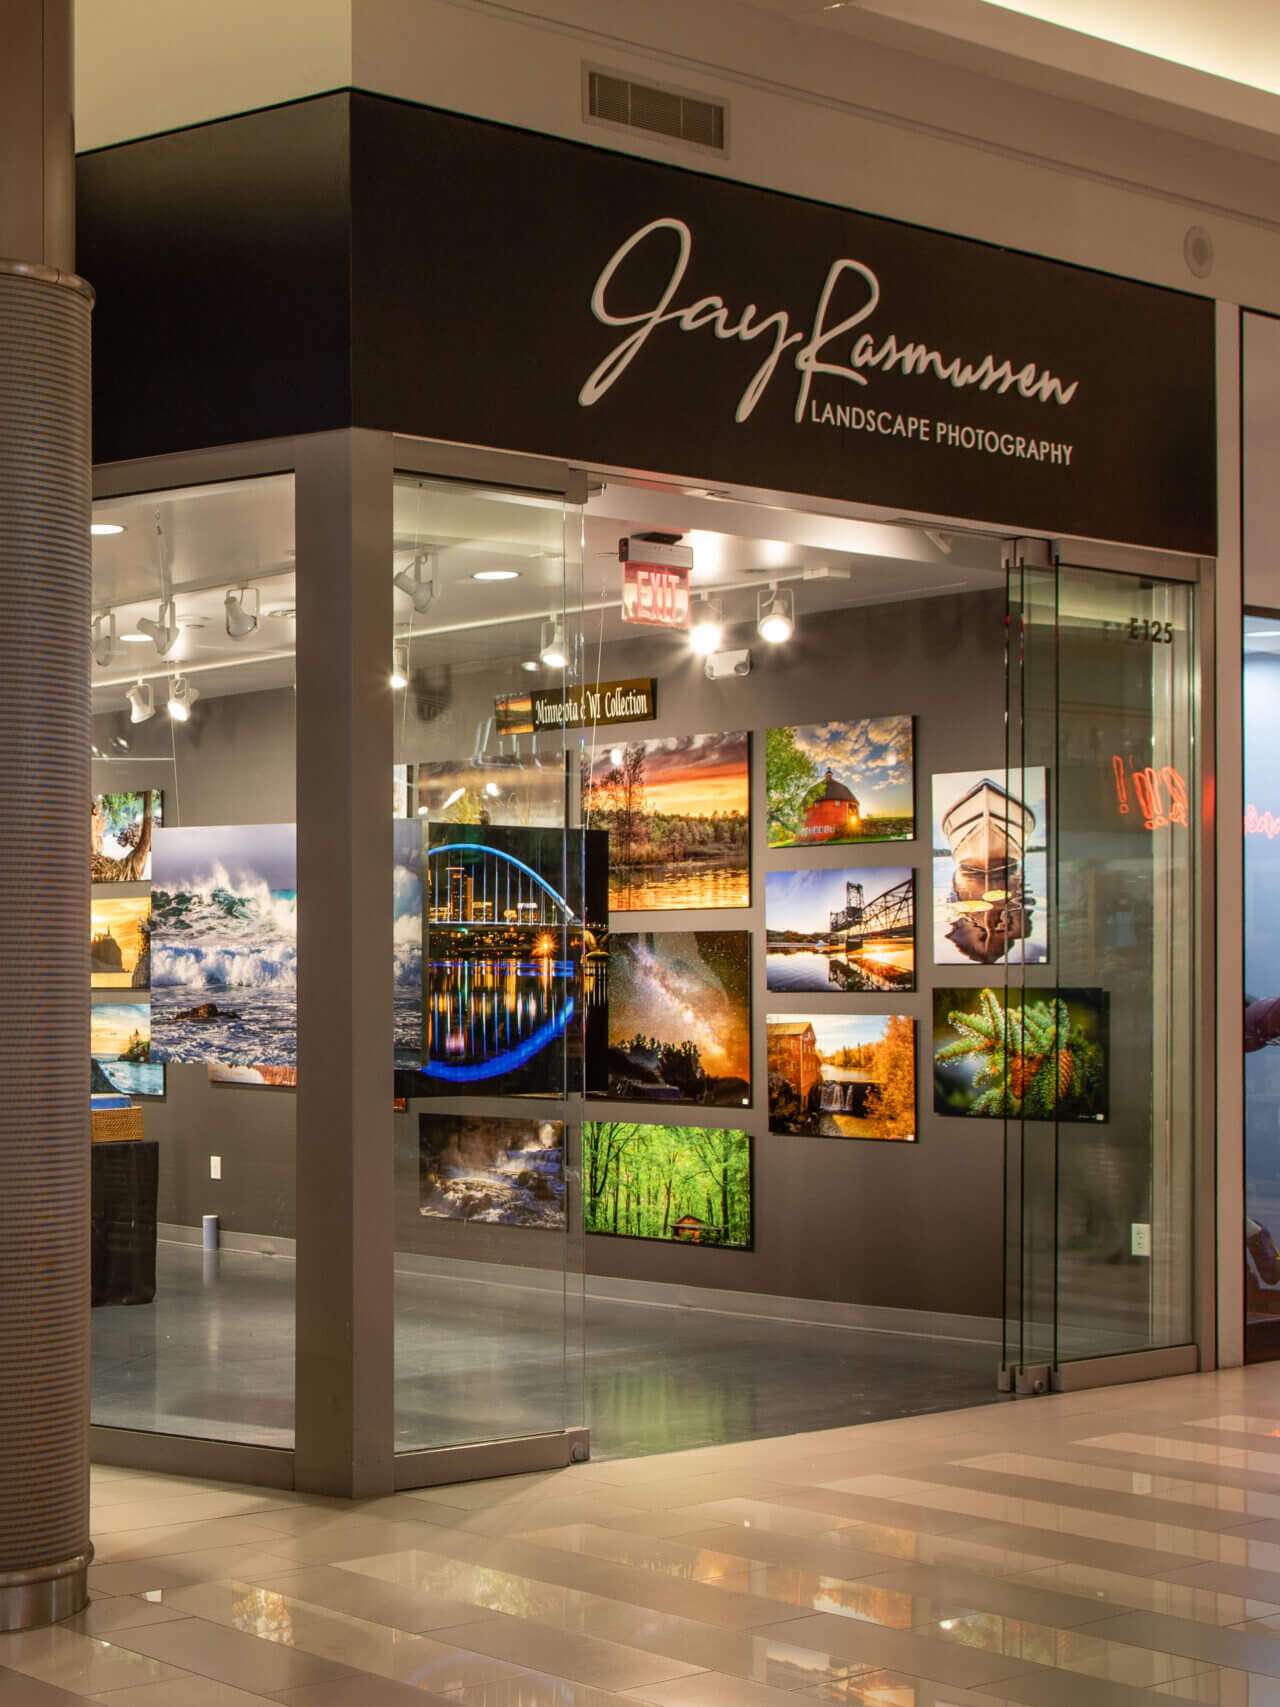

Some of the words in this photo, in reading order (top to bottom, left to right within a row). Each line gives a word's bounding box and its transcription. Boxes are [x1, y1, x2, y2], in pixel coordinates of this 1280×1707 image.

[577, 217, 804, 423] Jay
[795, 258, 1080, 423] Rasmussen
[810, 399, 931, 441] LANDSCAPE
[936, 421, 1073, 467] PHOTOGRAPHY
[636, 570, 681, 620] EXIT
[1127, 617, 1174, 644] E125
[604, 687, 648, 718] Collection
